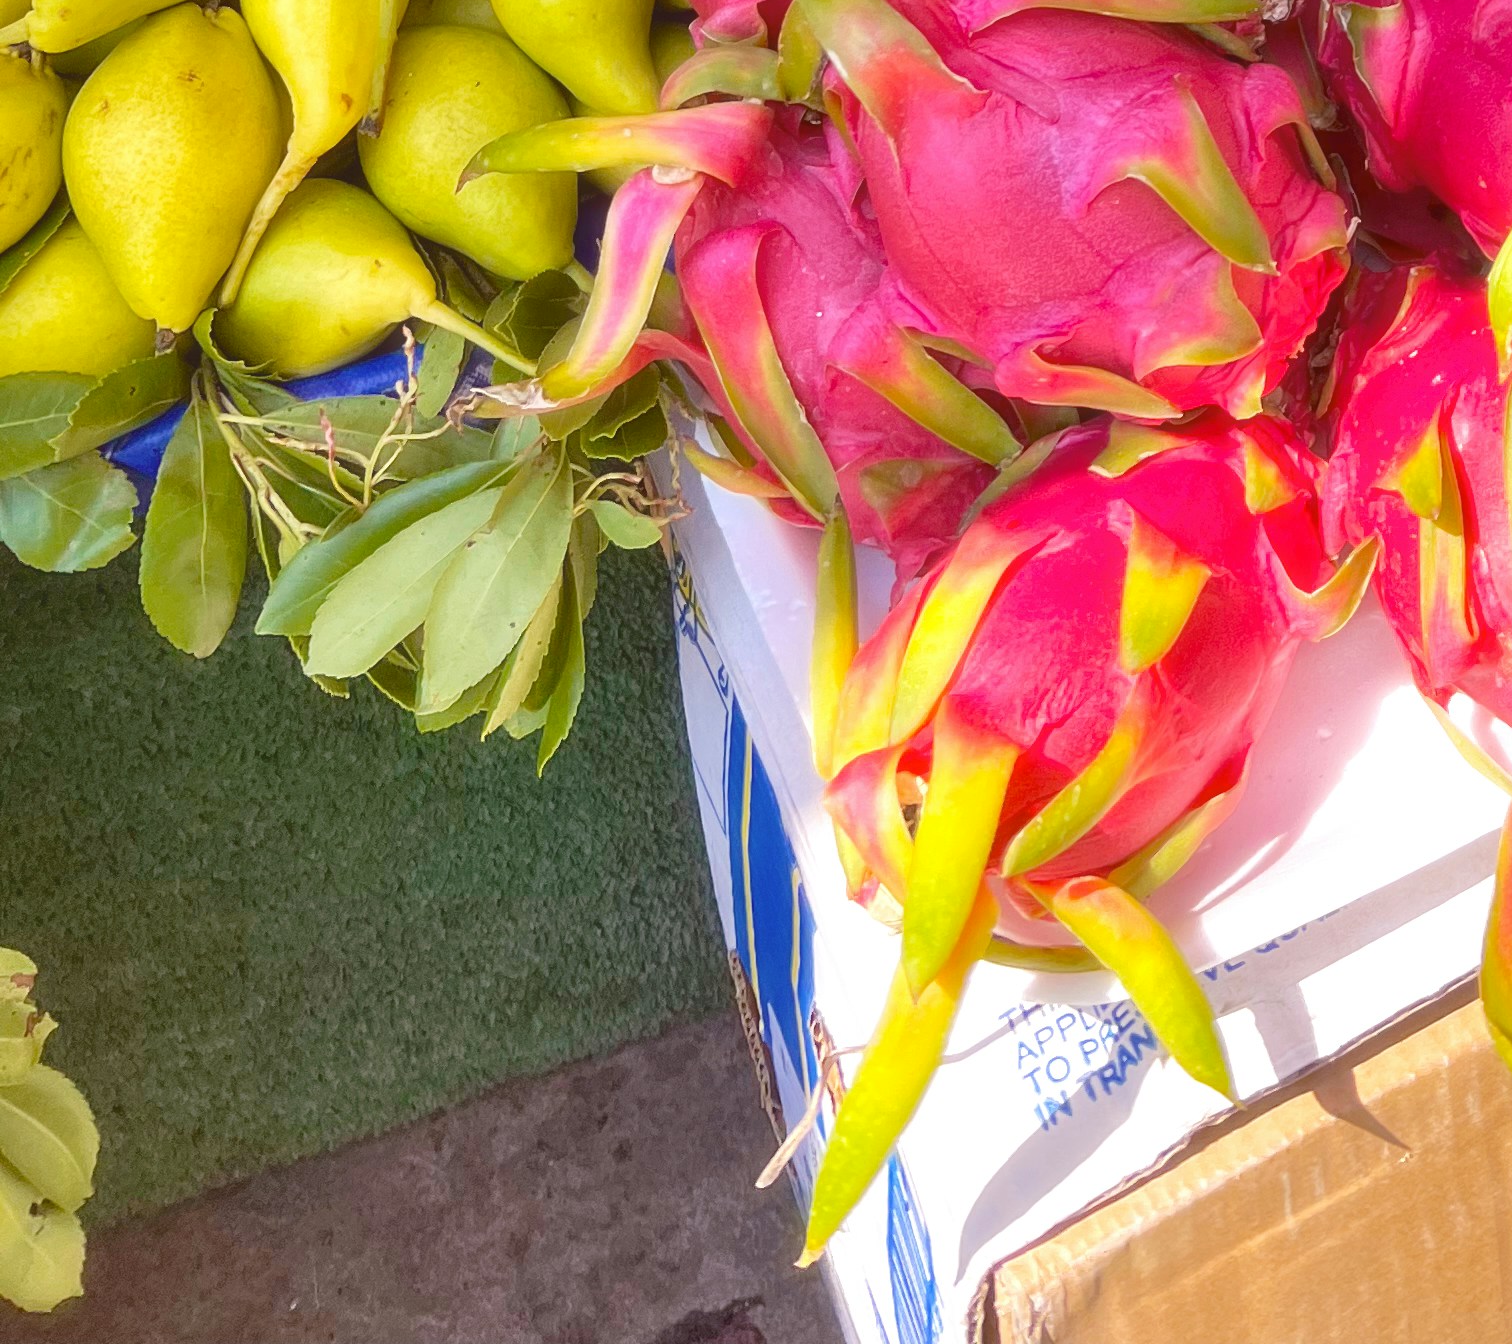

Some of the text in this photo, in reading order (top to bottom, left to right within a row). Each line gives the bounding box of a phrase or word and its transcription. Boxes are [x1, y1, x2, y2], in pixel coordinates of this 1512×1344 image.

[1022, 1000, 1142, 1095] TO PRE
[1033, 1022, 1159, 1131] IN TRAN
